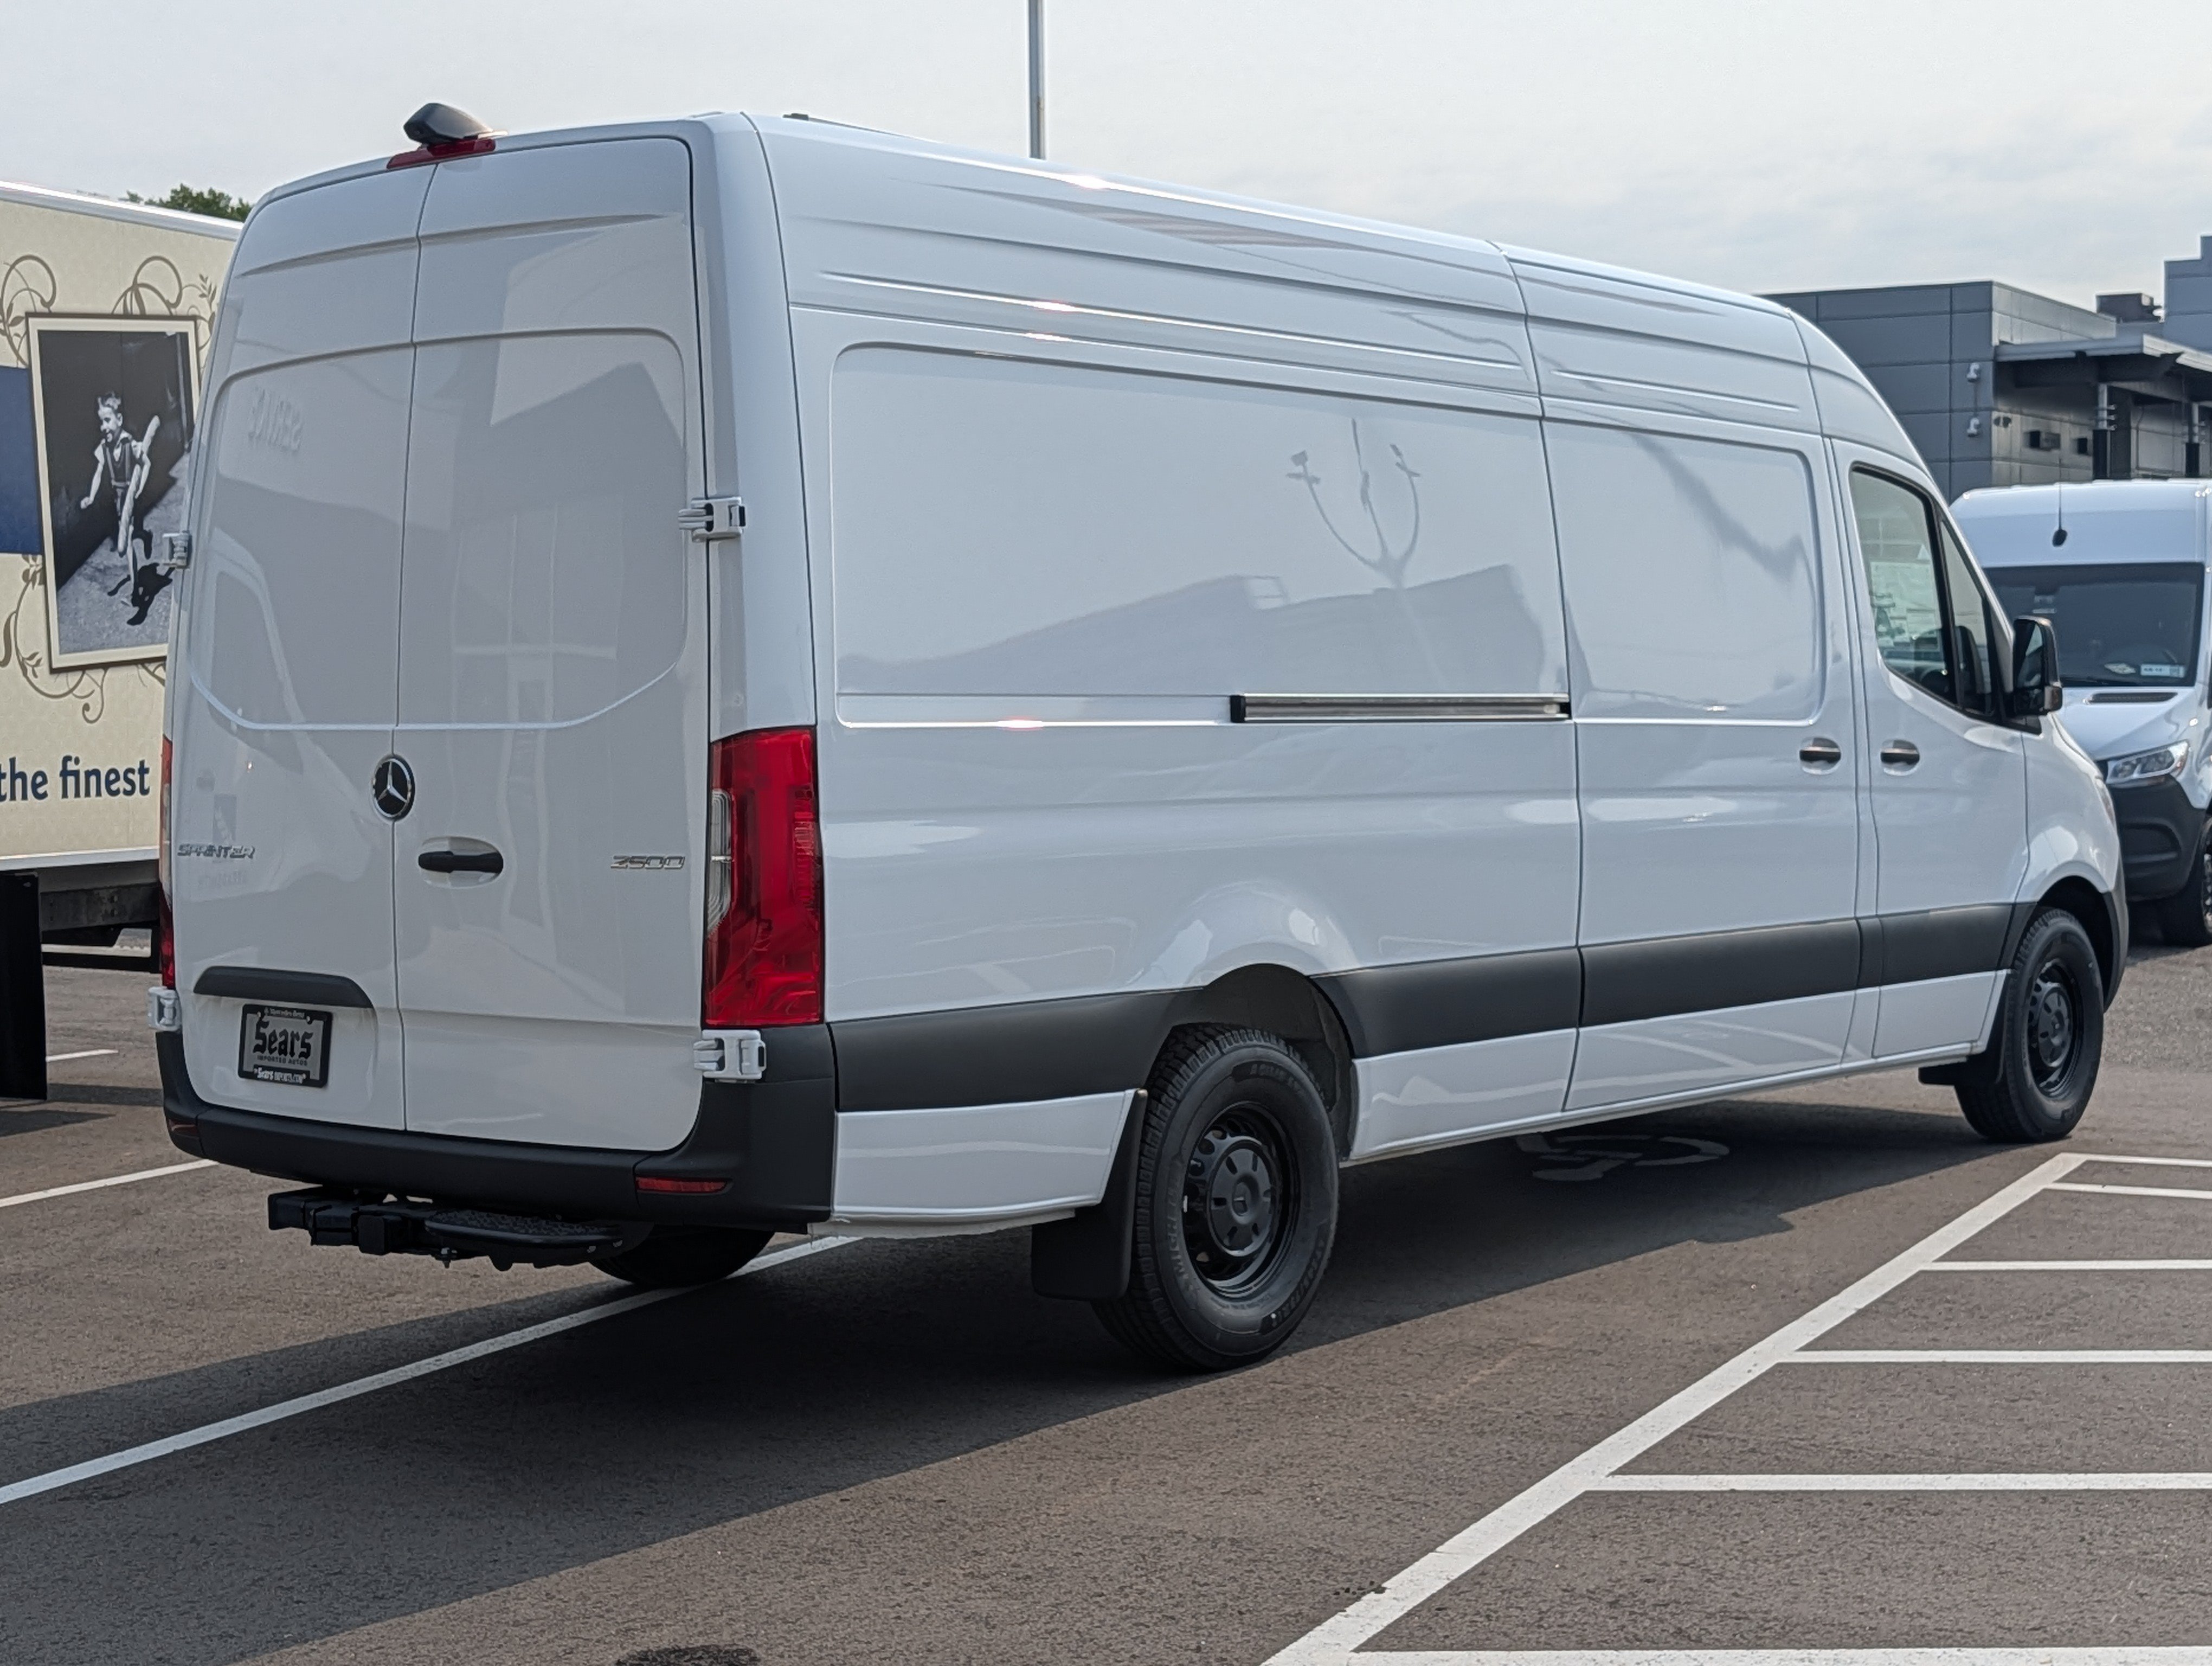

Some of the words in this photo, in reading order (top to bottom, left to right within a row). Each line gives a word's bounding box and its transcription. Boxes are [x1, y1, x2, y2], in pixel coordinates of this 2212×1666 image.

[59, 754, 150, 799] finest
[177, 843, 255, 859] SPRINTER
[610, 855, 685, 870] 2500
[253, 1017, 313, 1059] Sears
[257, 1055, 287, 1064] IMPORTED
